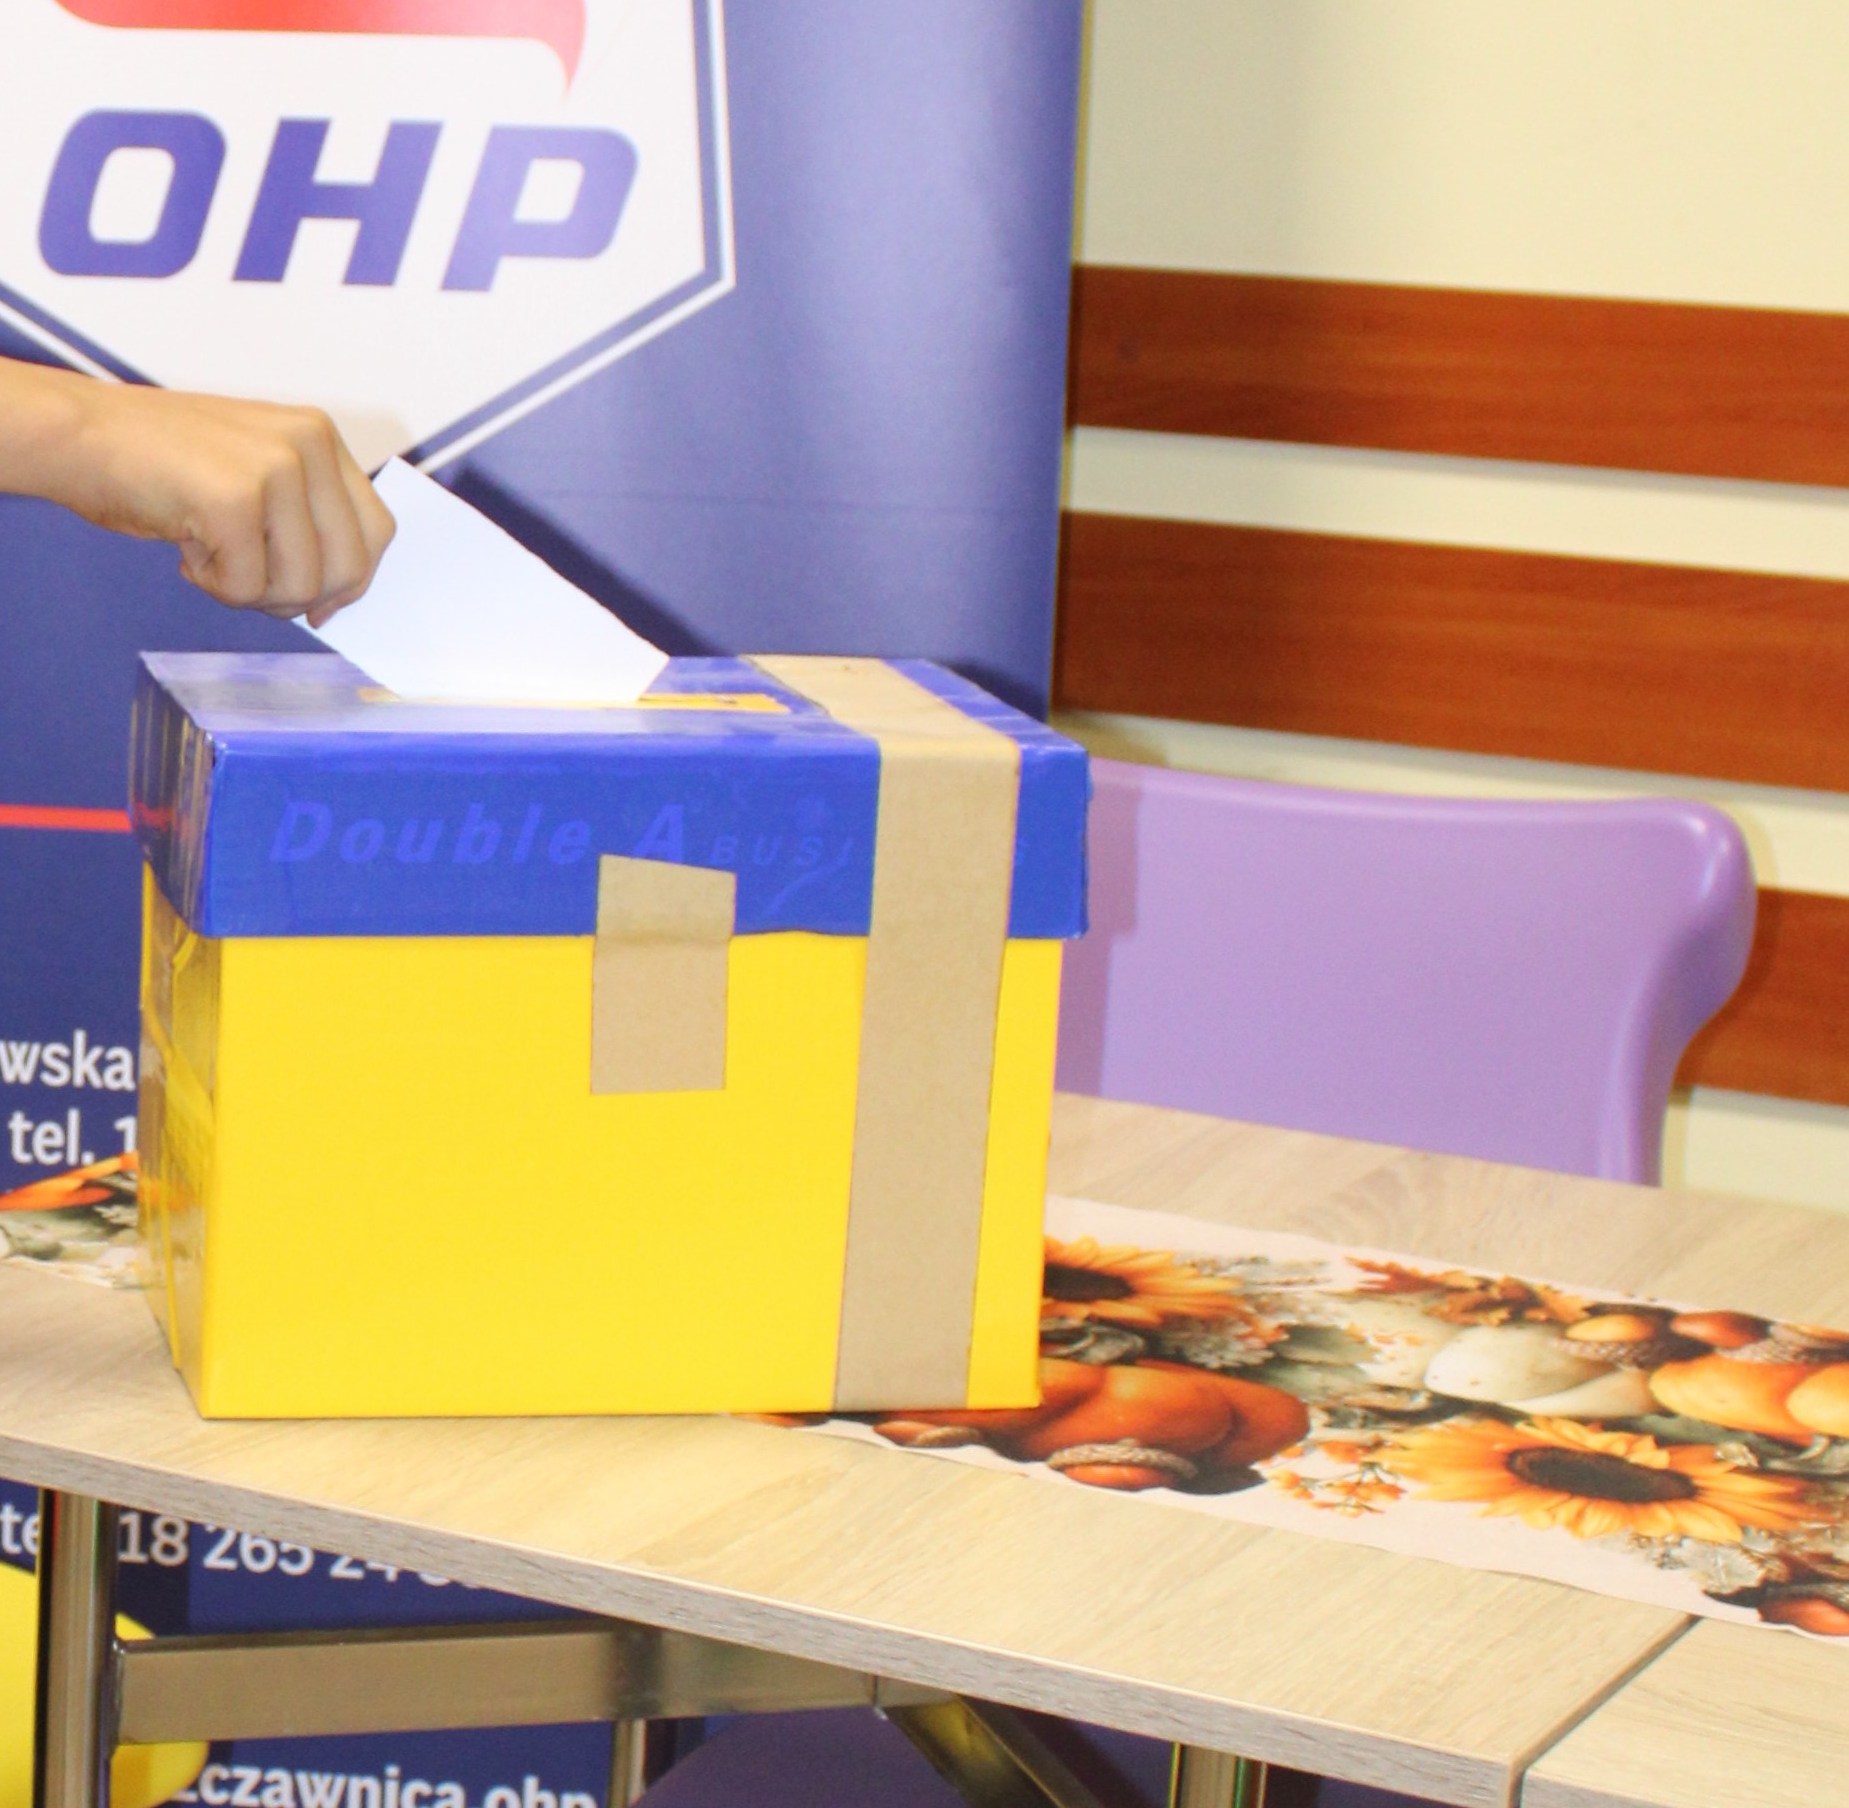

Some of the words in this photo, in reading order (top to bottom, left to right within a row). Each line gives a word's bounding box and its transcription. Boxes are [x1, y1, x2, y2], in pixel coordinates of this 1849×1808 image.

[37, 107, 640, 293] OHP
[268, 803, 590, 867] Double
[8, 1108, 96, 1166] tel.
[117, 1511, 190, 1567] 18
